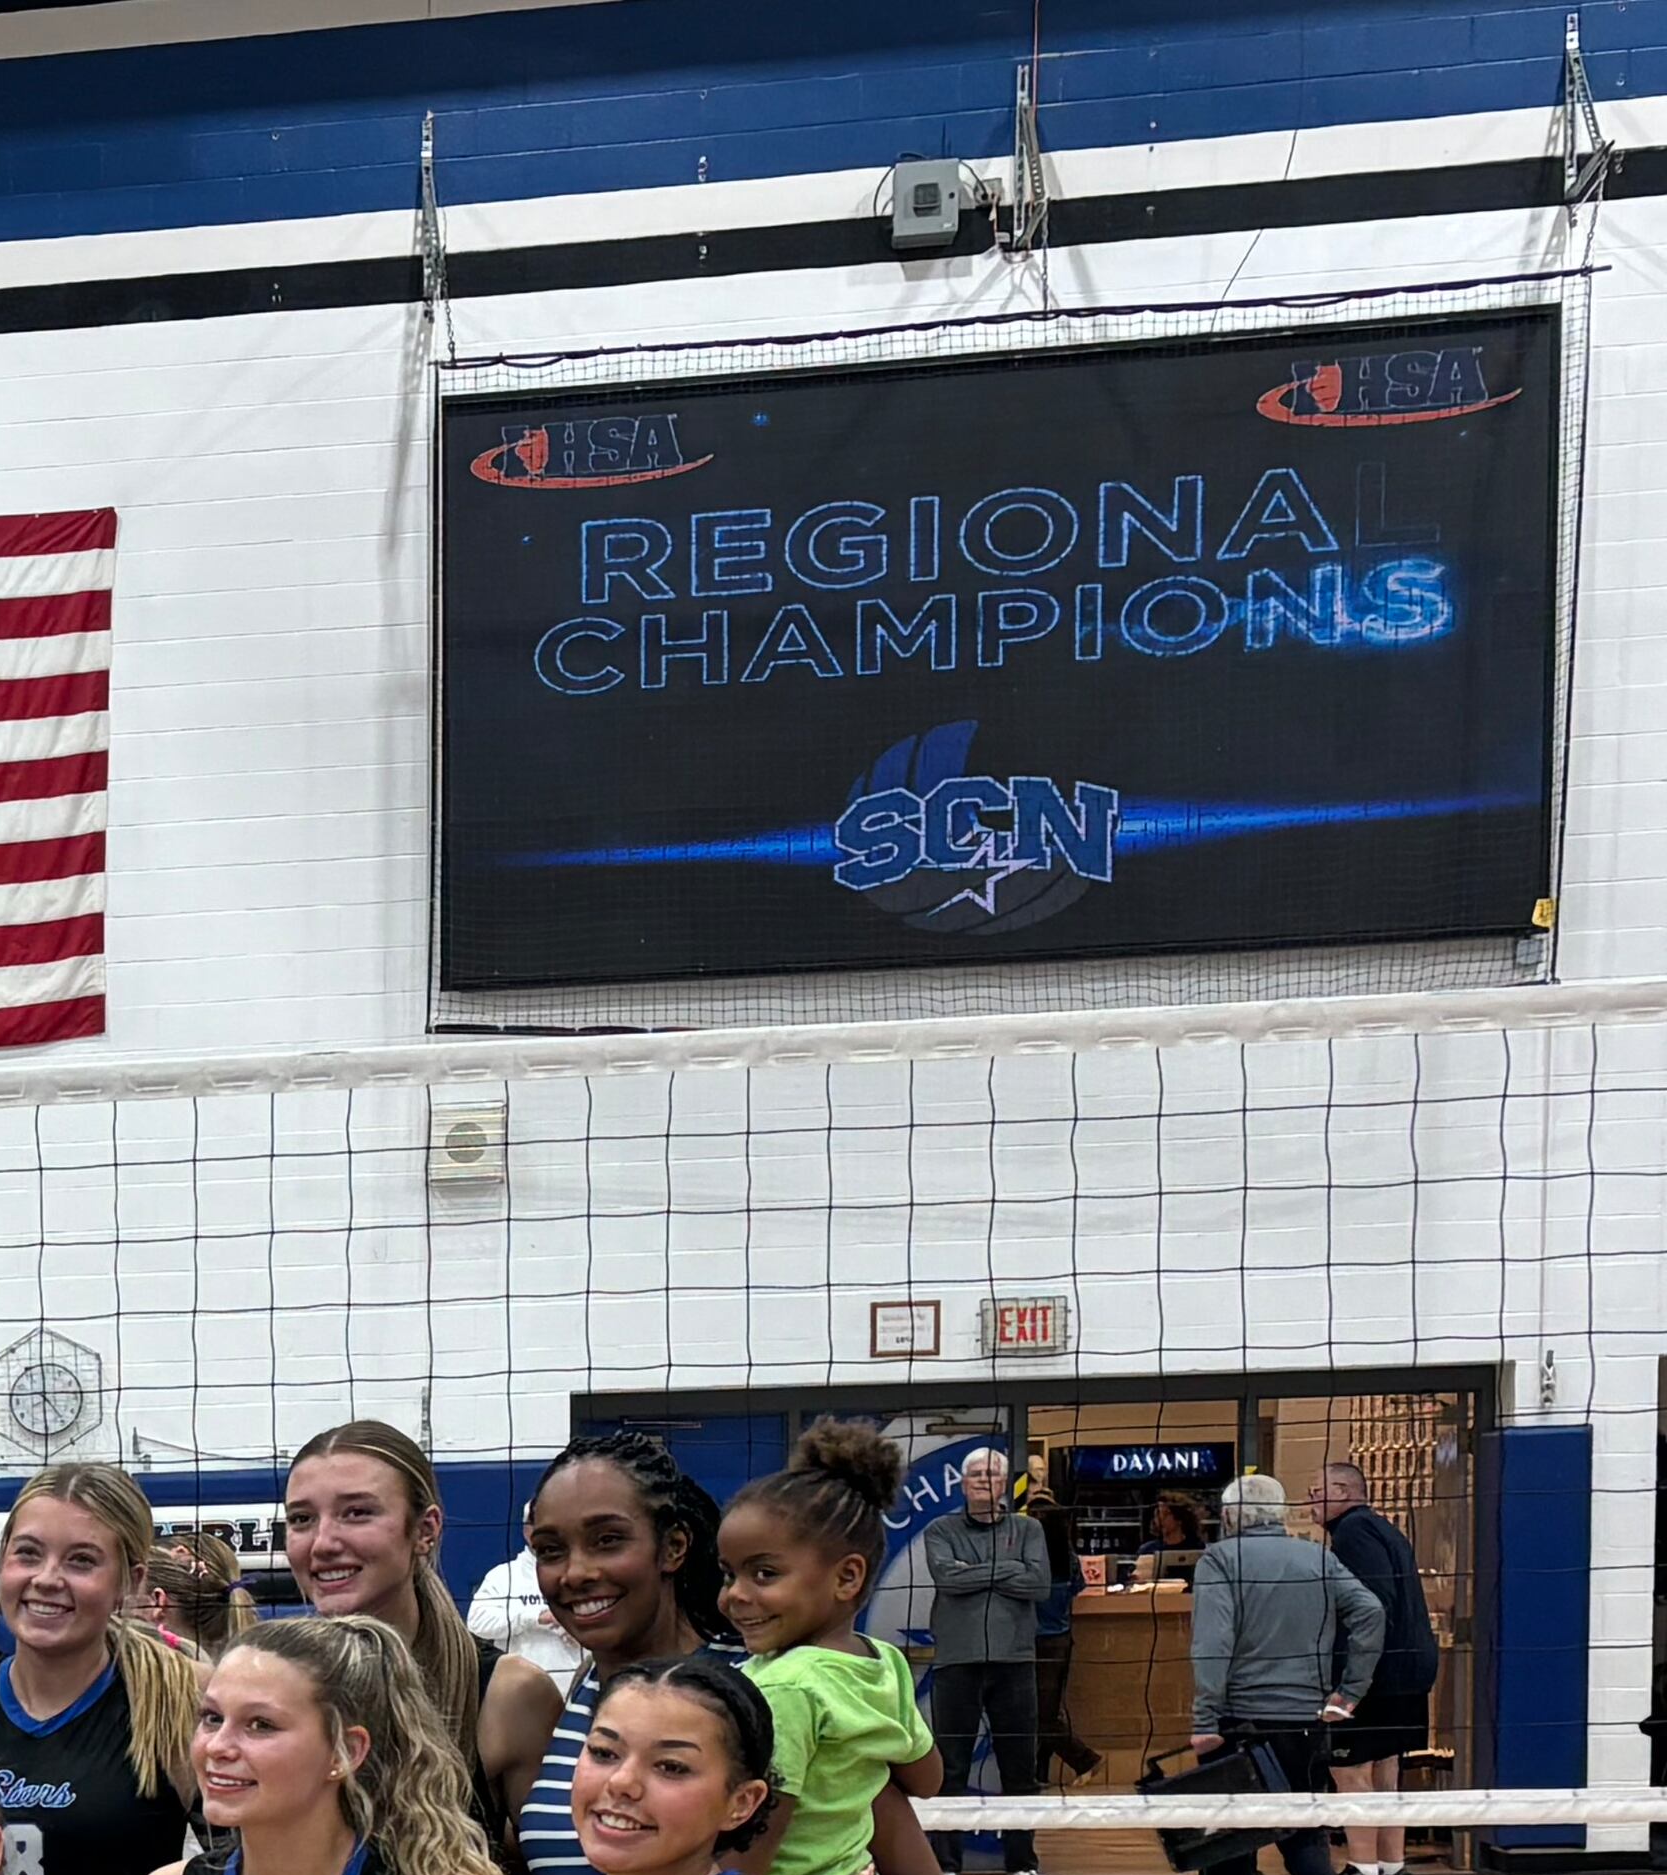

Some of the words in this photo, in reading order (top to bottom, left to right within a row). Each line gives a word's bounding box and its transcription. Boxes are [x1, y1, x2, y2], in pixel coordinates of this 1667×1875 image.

[580, 460, 1441, 604] REGIONAL
[533, 556, 1455, 697] CHAMPIONS
[999, 1306, 1052, 1344] EXIT
[1113, 1450, 1199, 1475] DASANI
